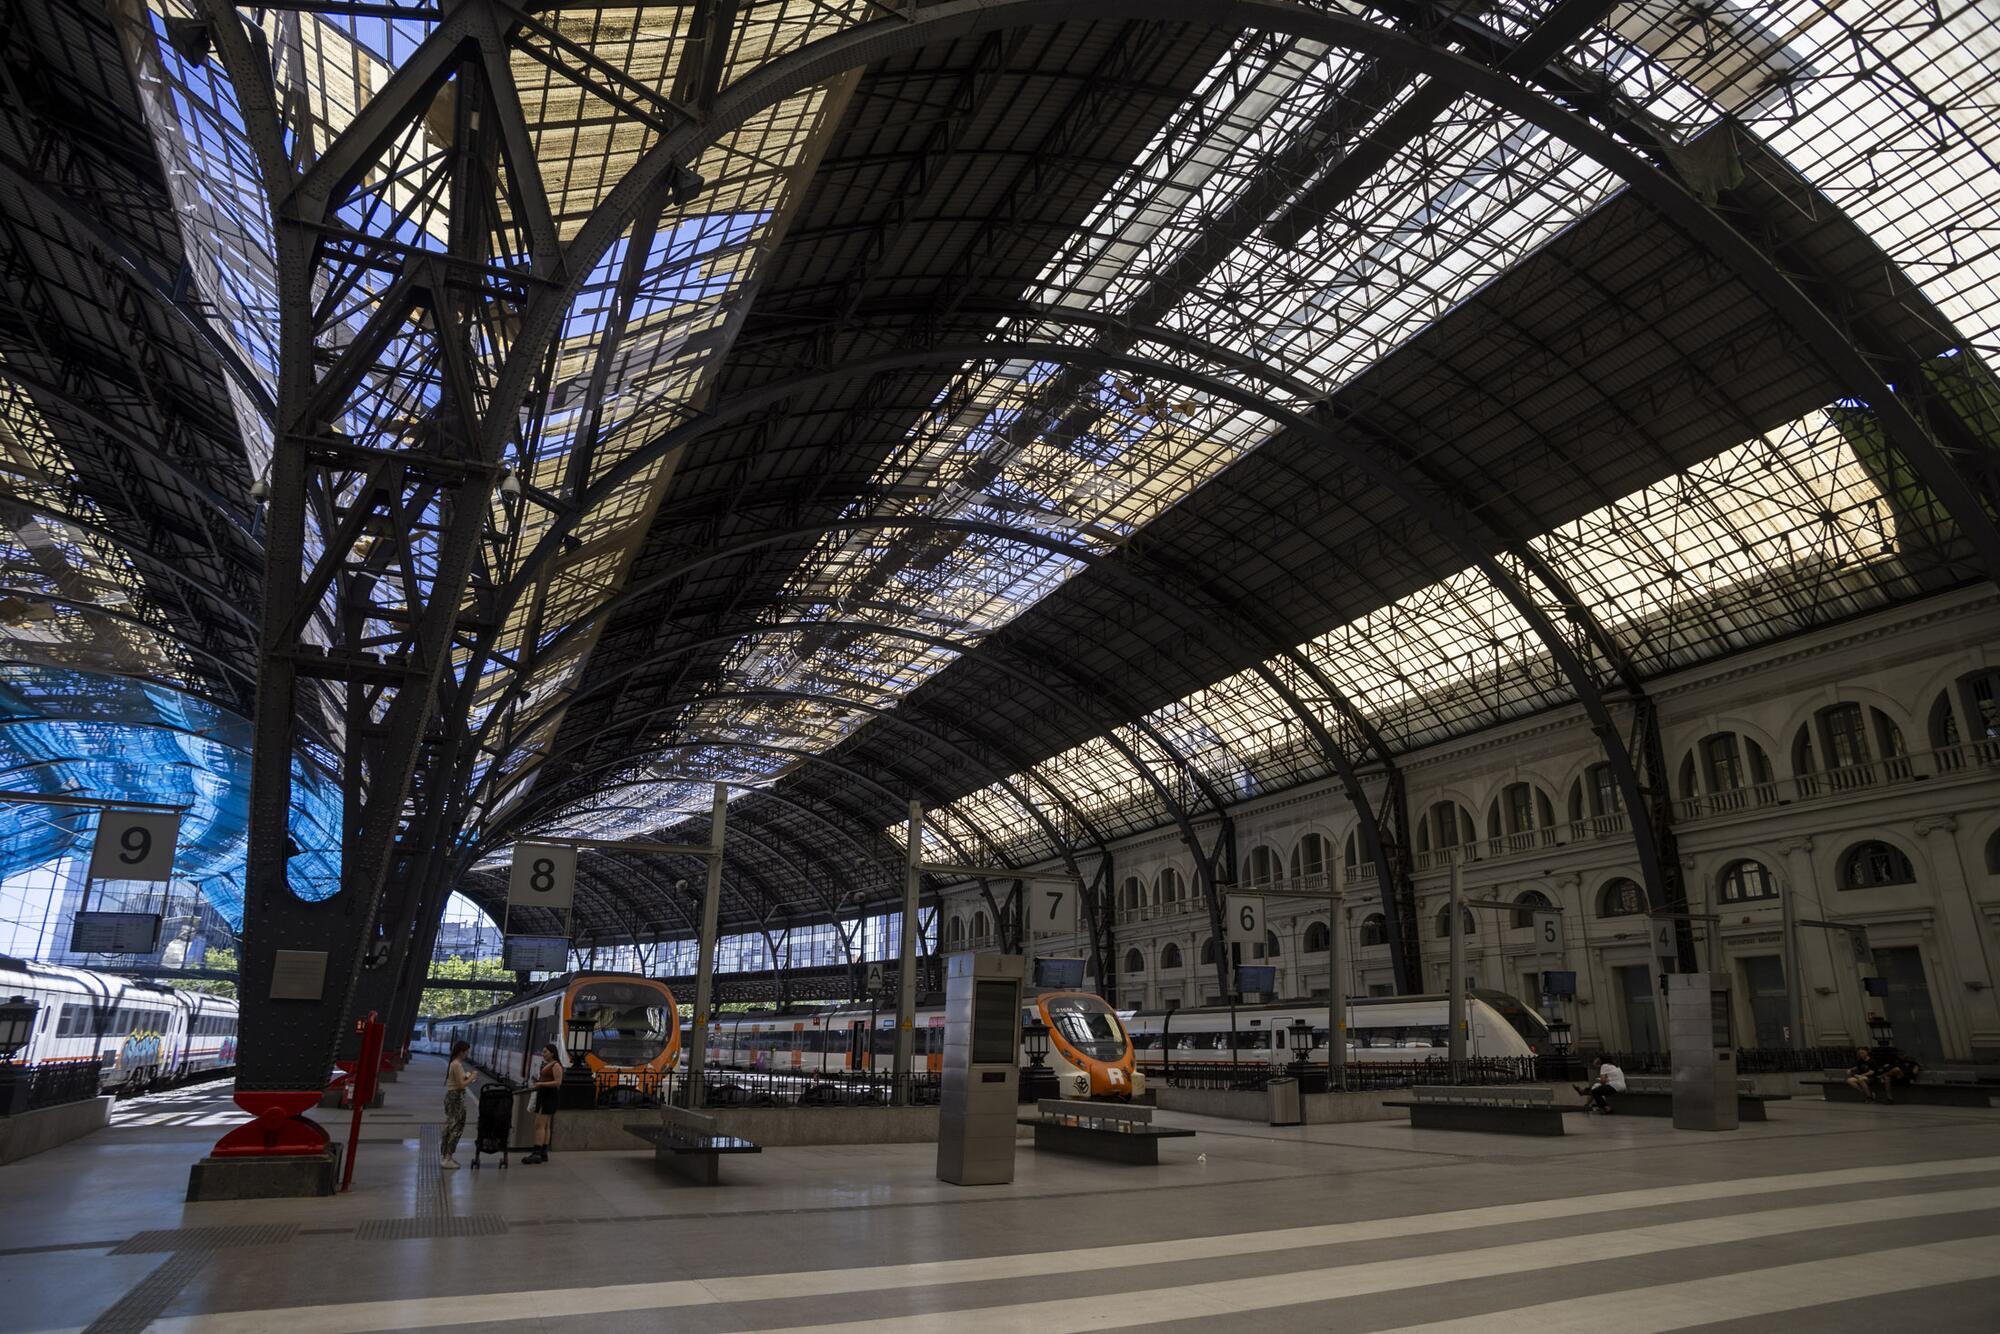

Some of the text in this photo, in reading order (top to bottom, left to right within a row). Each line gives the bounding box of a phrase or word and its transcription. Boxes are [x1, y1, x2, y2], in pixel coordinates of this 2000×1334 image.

[120, 827, 151, 864] 9
[531, 859, 555, 893] 8
[1047, 892, 1063, 920] 7
[1240, 906, 1255, 931] 6
[1545, 921, 1555, 942] 5
[1659, 927, 1670, 947] 4
[1855, 937, 1865, 955] 3
[870, 966, 881, 980] A
[1107, 1068, 1125, 1085] R
